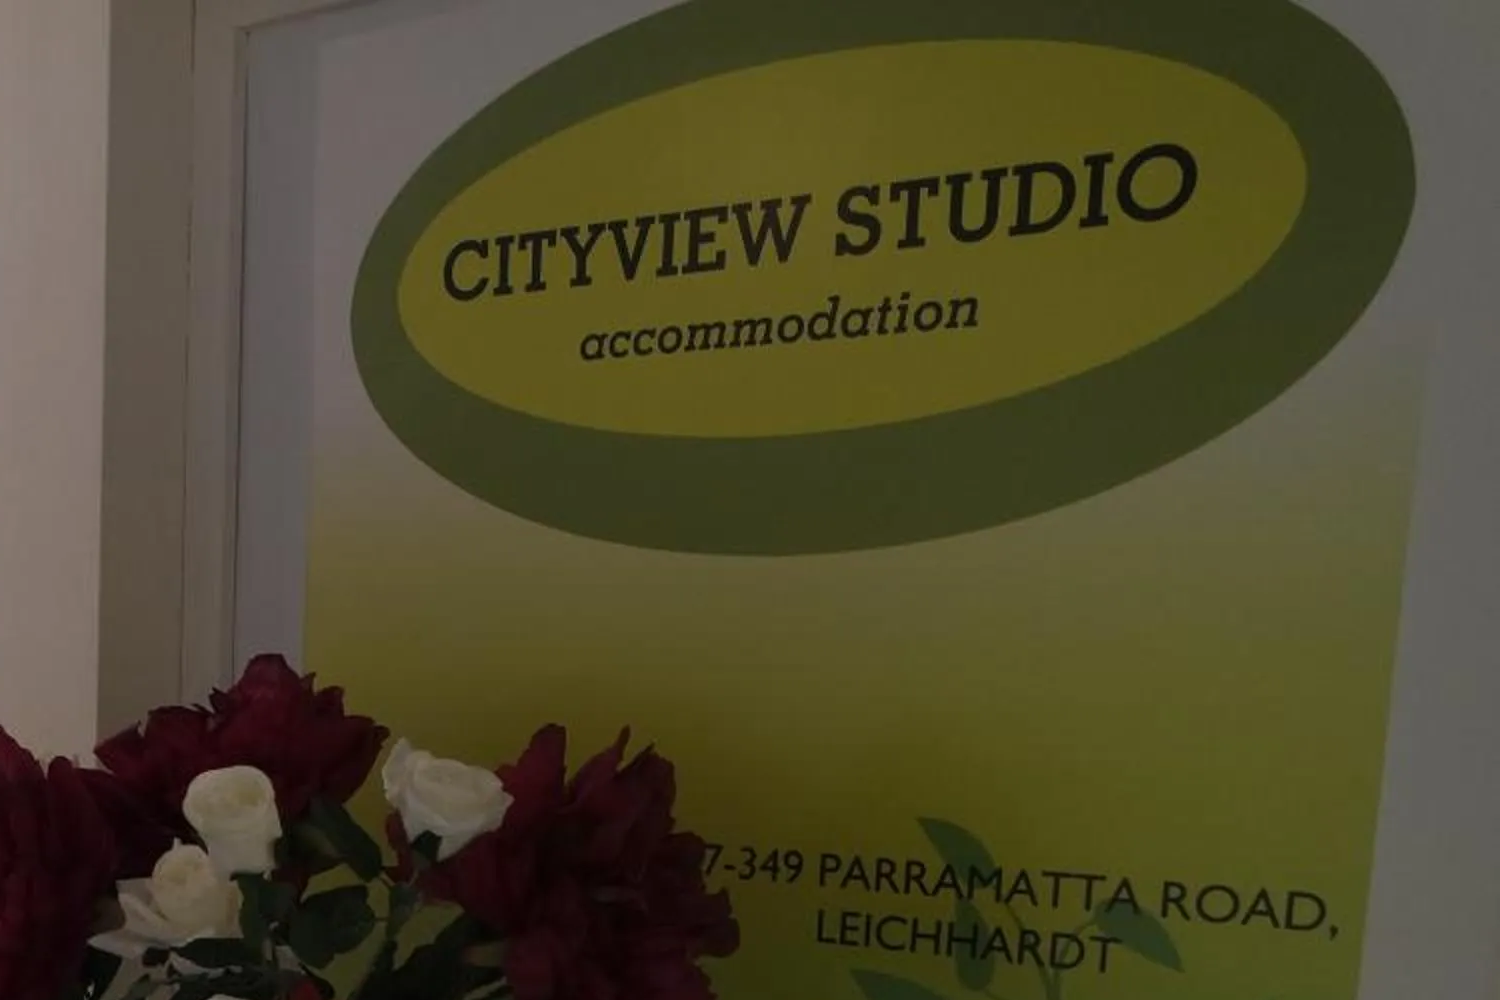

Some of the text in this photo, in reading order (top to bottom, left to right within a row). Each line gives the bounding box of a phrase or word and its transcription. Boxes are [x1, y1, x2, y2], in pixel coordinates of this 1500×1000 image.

[443, 143, 1198, 302] CITYVIEW STUDIO
[580, 292, 979, 362] accommodation
[819, 853, 1139, 915] PARRAMATTA
[1161, 880, 1338, 941] ROAD,
[817, 909, 1123, 974] LEICHHARDT
